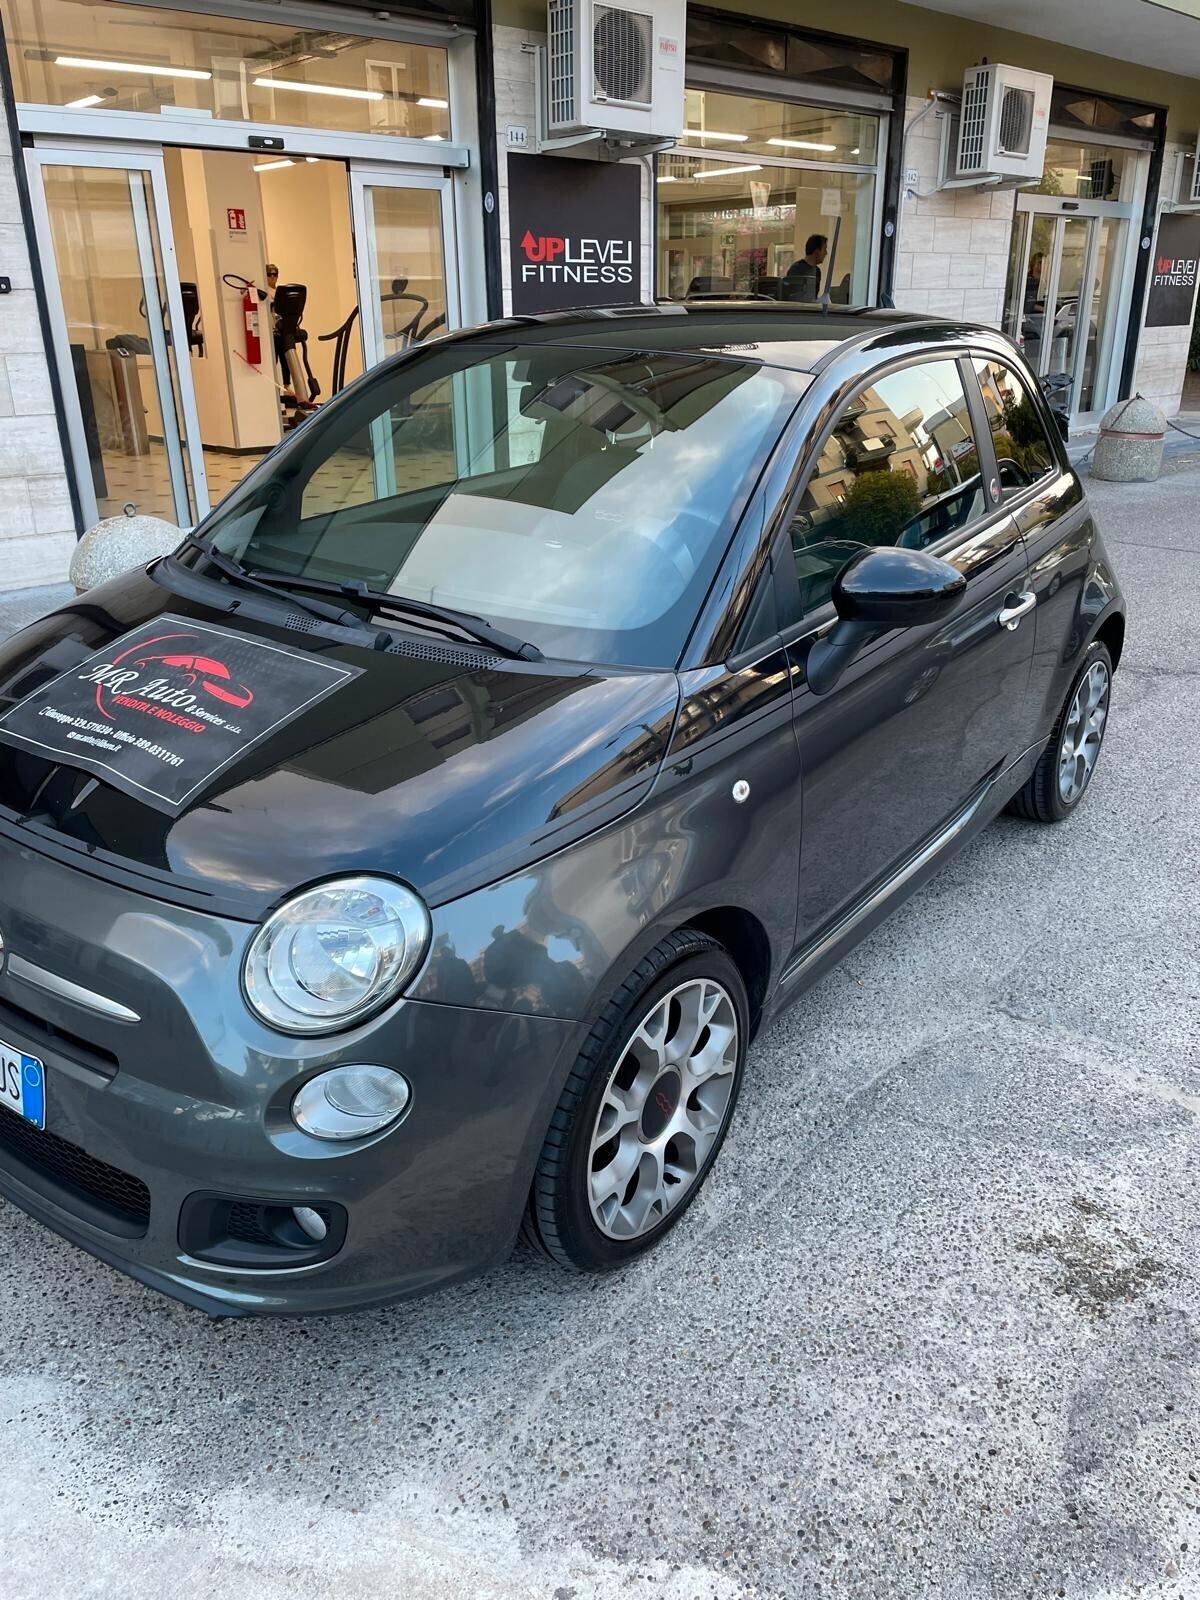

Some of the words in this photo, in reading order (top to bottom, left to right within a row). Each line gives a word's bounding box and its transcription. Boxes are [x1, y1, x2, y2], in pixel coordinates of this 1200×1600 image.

[510, 130, 525, 143] 144
[521, 264, 633, 283] FITNESS
[1154, 275, 1194, 286] FITNESS
[78, 664, 139, 695] MR
[121, 678, 197, 707] Auto
[191, 707, 226, 726] Services
[112, 695, 151, 712] VENDITA
[154, 708, 206, 733] NOLEGGIO
[132, 737, 185, 767] 389.0311761
